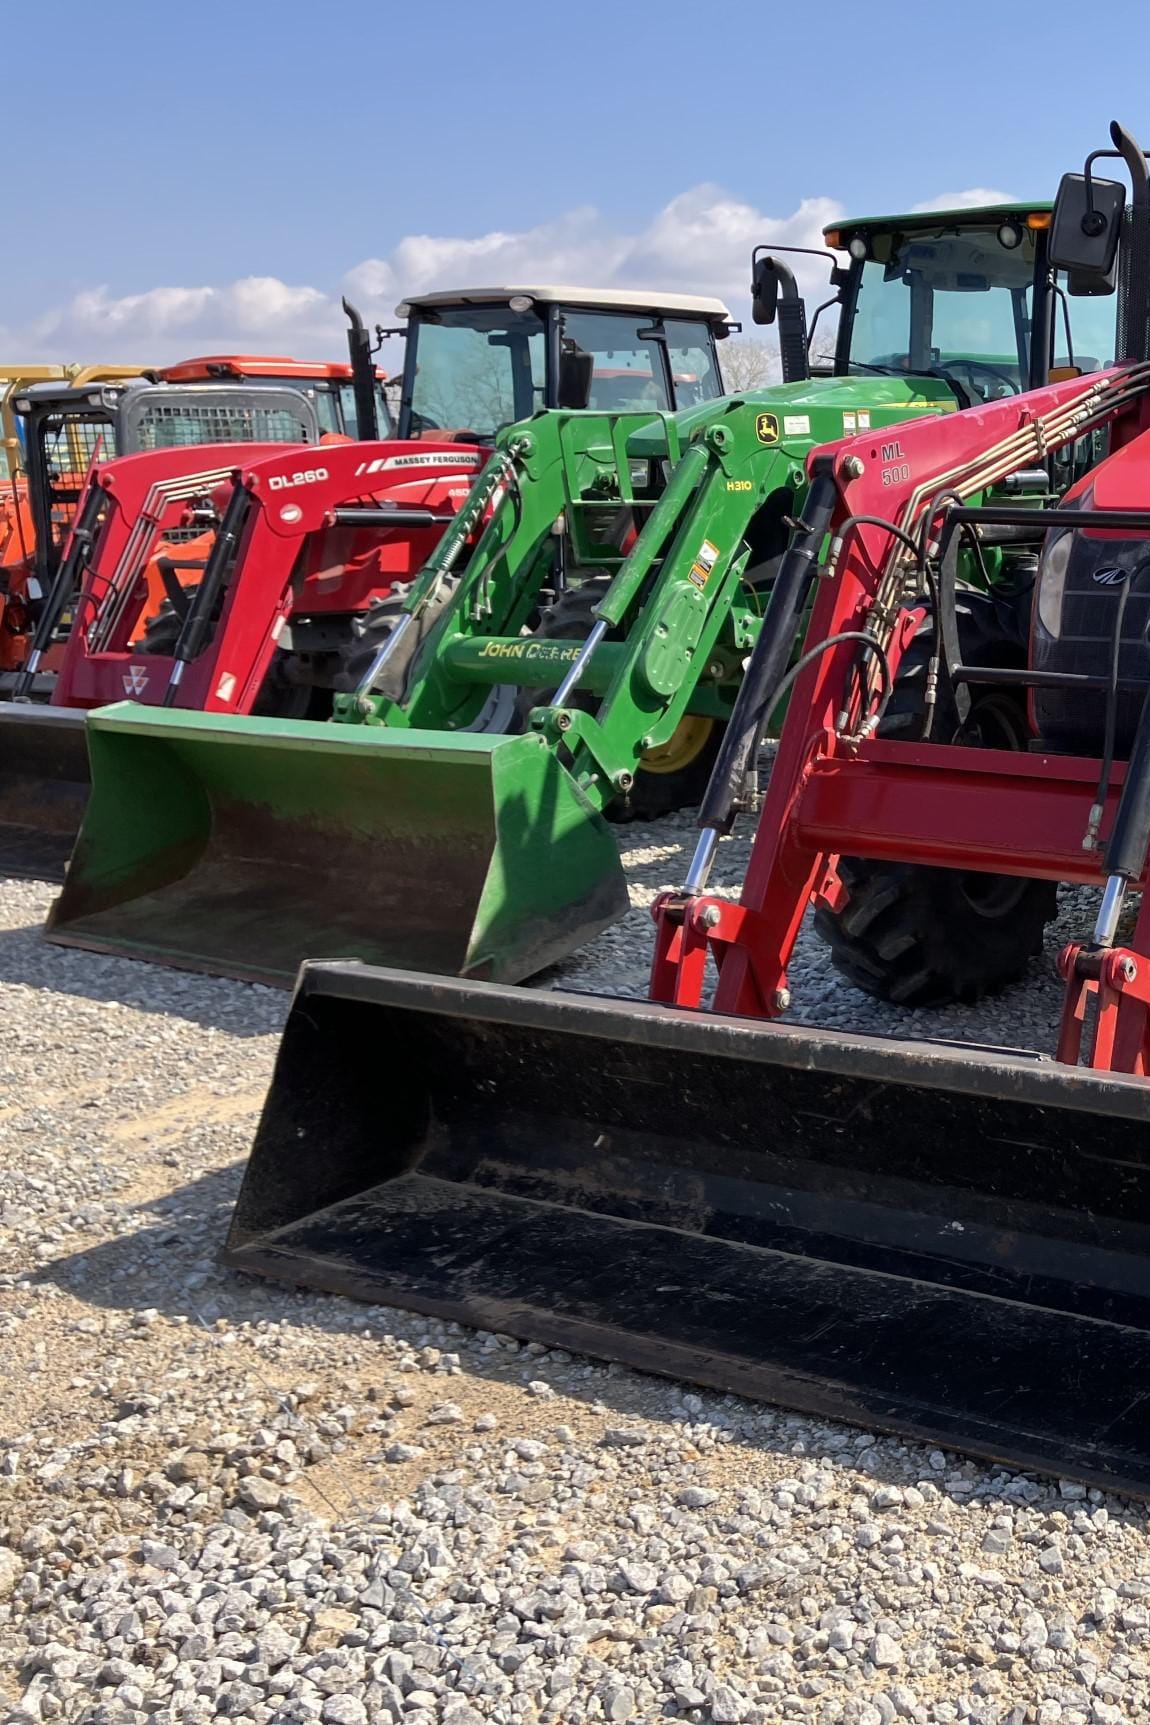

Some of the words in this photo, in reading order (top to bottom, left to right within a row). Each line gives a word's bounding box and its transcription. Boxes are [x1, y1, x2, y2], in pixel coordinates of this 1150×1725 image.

[394, 456, 431, 466] MASSEY
[433, 455, 479, 464] FERGUSON
[881, 440, 905, 463] ML
[268, 467, 329, 490] DL260
[881, 463, 910, 487] 500
[726, 480, 752, 491] H310
[478, 641, 525, 658] JOHN
